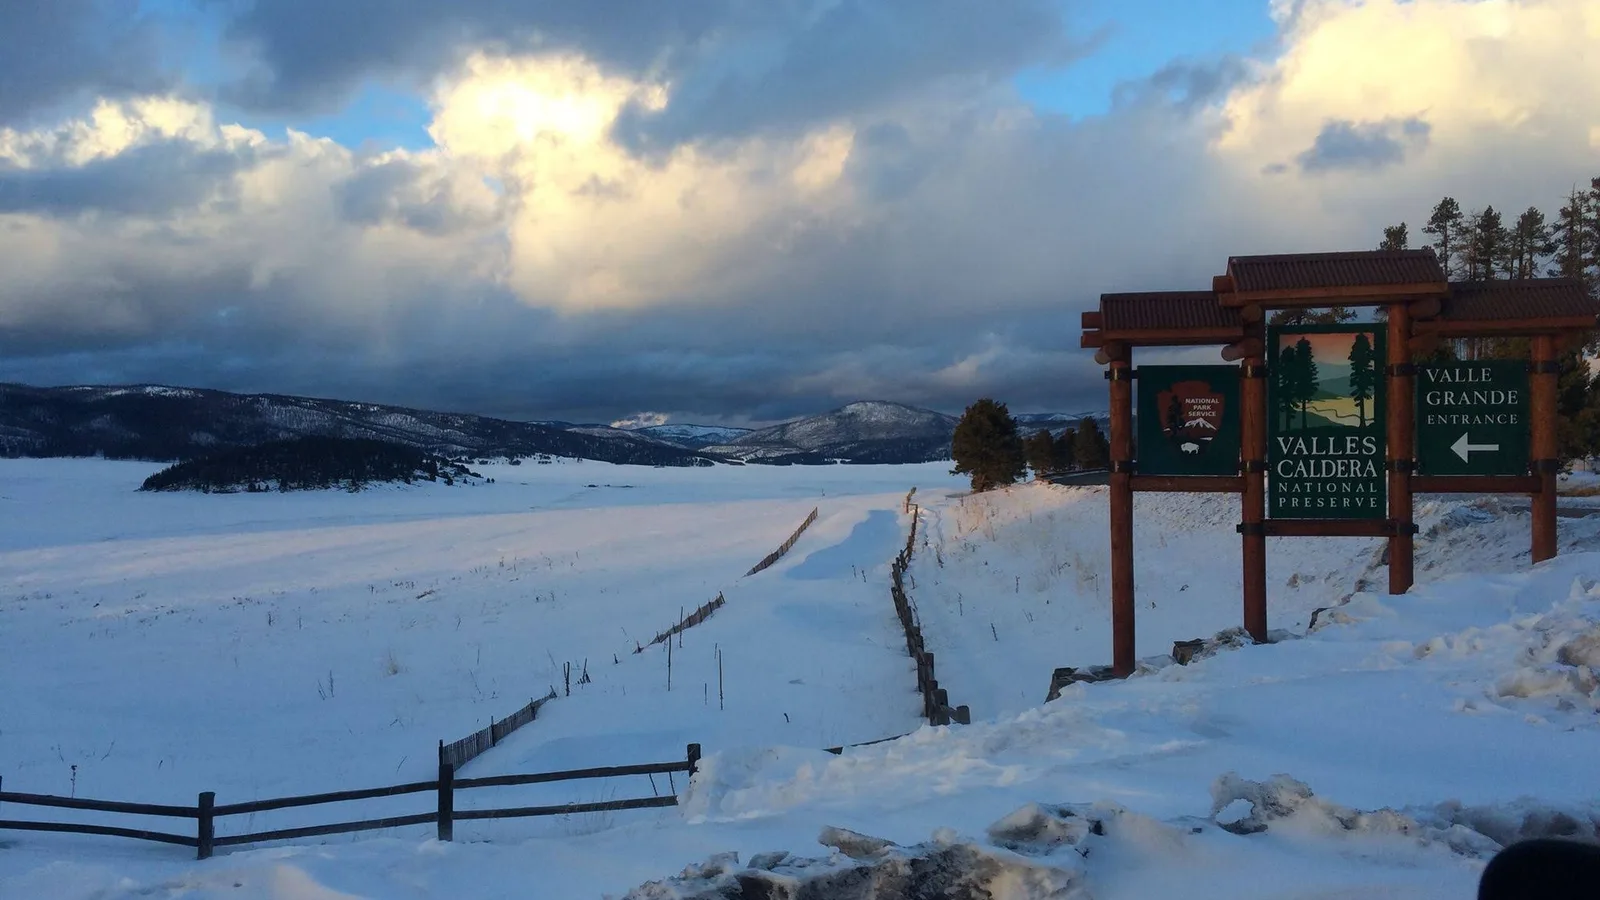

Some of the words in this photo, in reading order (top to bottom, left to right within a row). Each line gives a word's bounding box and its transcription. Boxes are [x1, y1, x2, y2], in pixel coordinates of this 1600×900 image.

[1426, 368, 1492, 382] VALLE
[1426, 390, 1518, 406] GRANDE
[1427, 414, 1518, 425] ENTRANCE
[1276, 436, 1377, 455] VALLES
[1277, 459, 1378, 478] CALDERA
[1278, 482, 1378, 493] NATIONAL
[1278, 497, 1378, 508] PRESERVE
